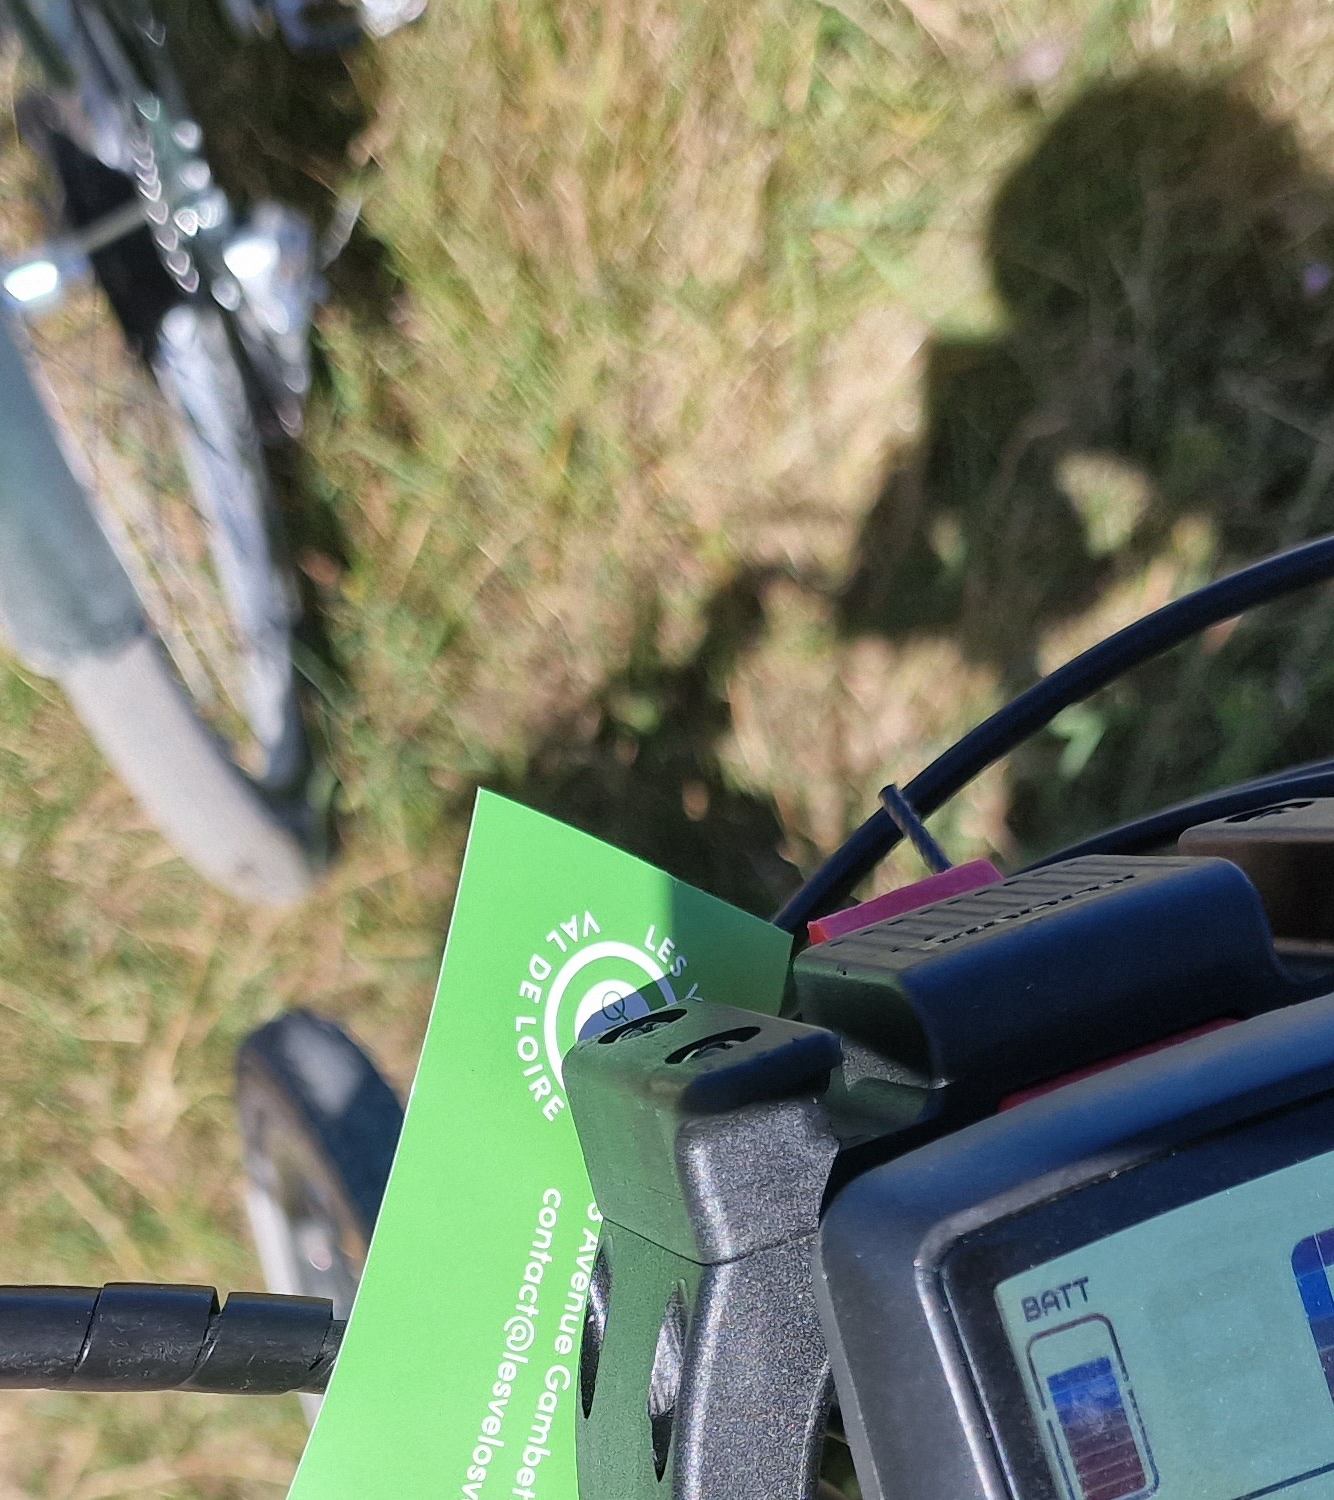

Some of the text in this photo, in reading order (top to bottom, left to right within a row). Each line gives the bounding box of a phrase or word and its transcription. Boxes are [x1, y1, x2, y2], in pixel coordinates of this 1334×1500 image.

[644, 924, 688, 978] LES
[515, 911, 601, 1122] VAL DE LOIRE
[554, 1227, 598, 1355] Avenue
[1021, 1276, 1091, 1323] BATT
